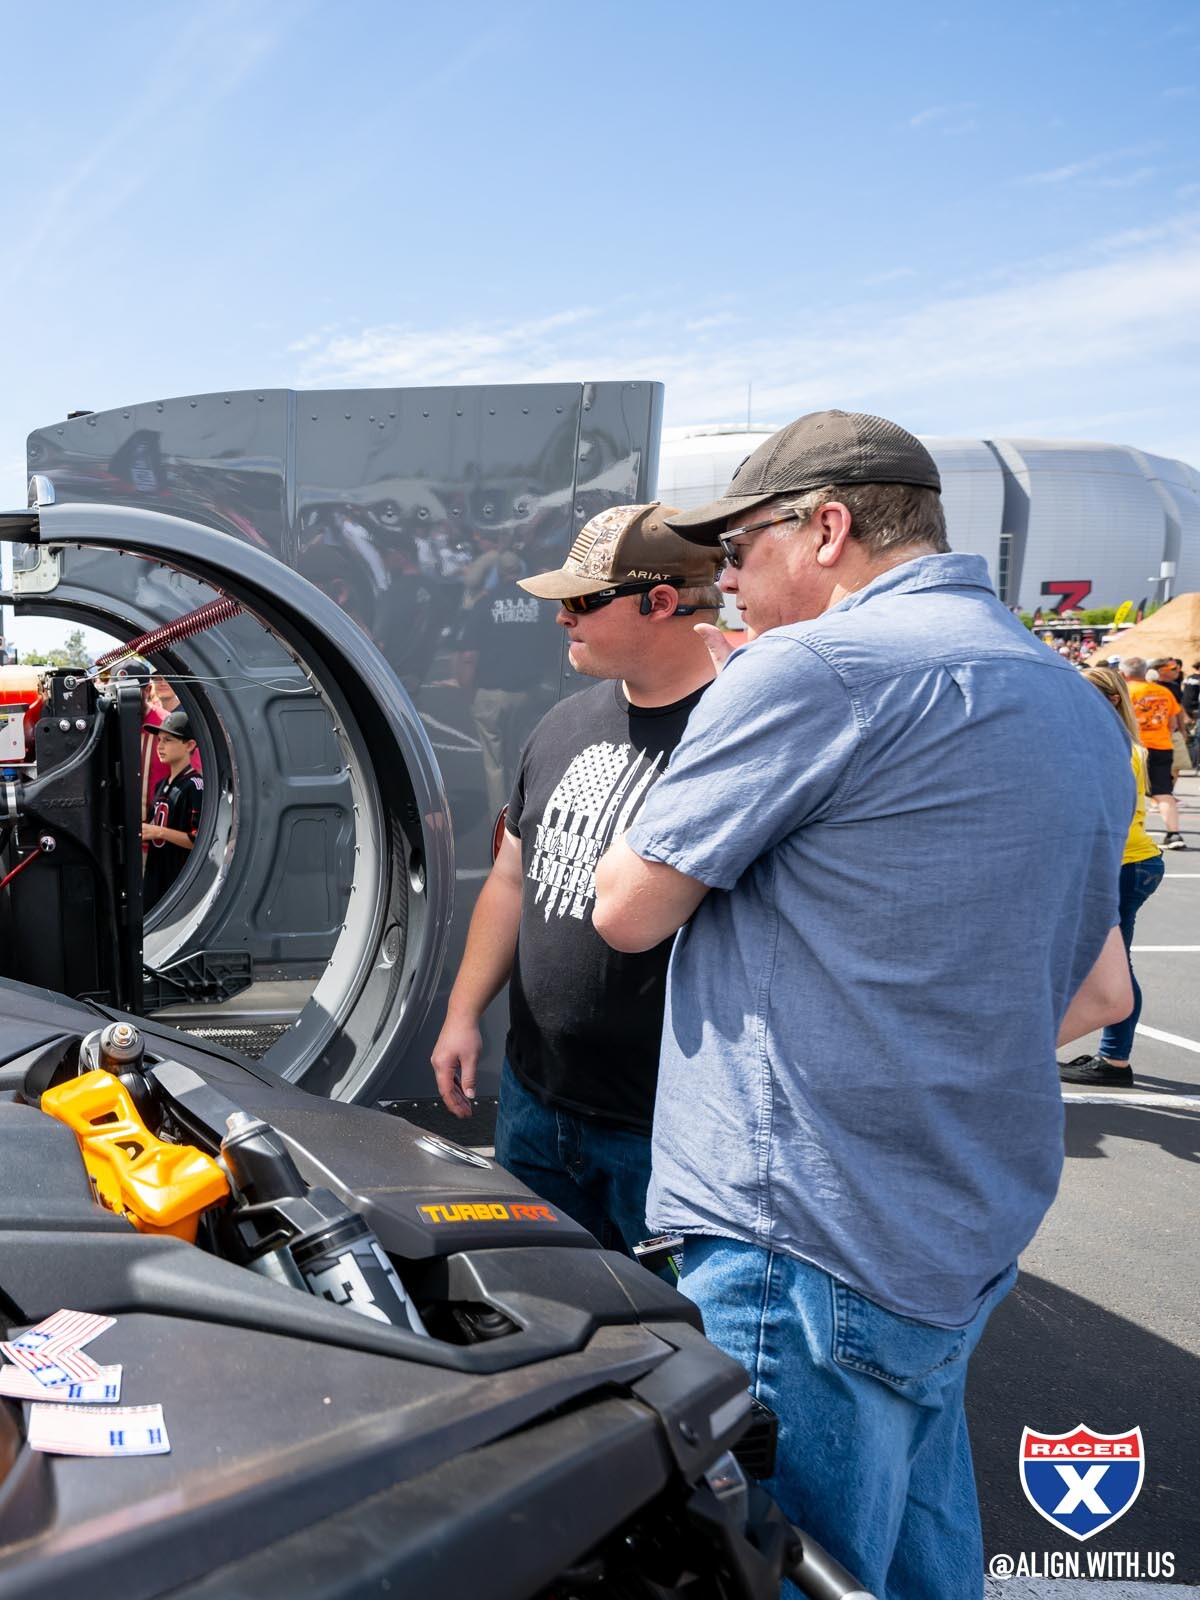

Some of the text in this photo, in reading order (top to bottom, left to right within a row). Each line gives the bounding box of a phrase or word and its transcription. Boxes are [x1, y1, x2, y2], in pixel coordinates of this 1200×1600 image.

[627, 570, 671, 581] ARIAT
[533, 824, 603, 867] MADE
[420, 1203, 558, 1223] TURBO RR
